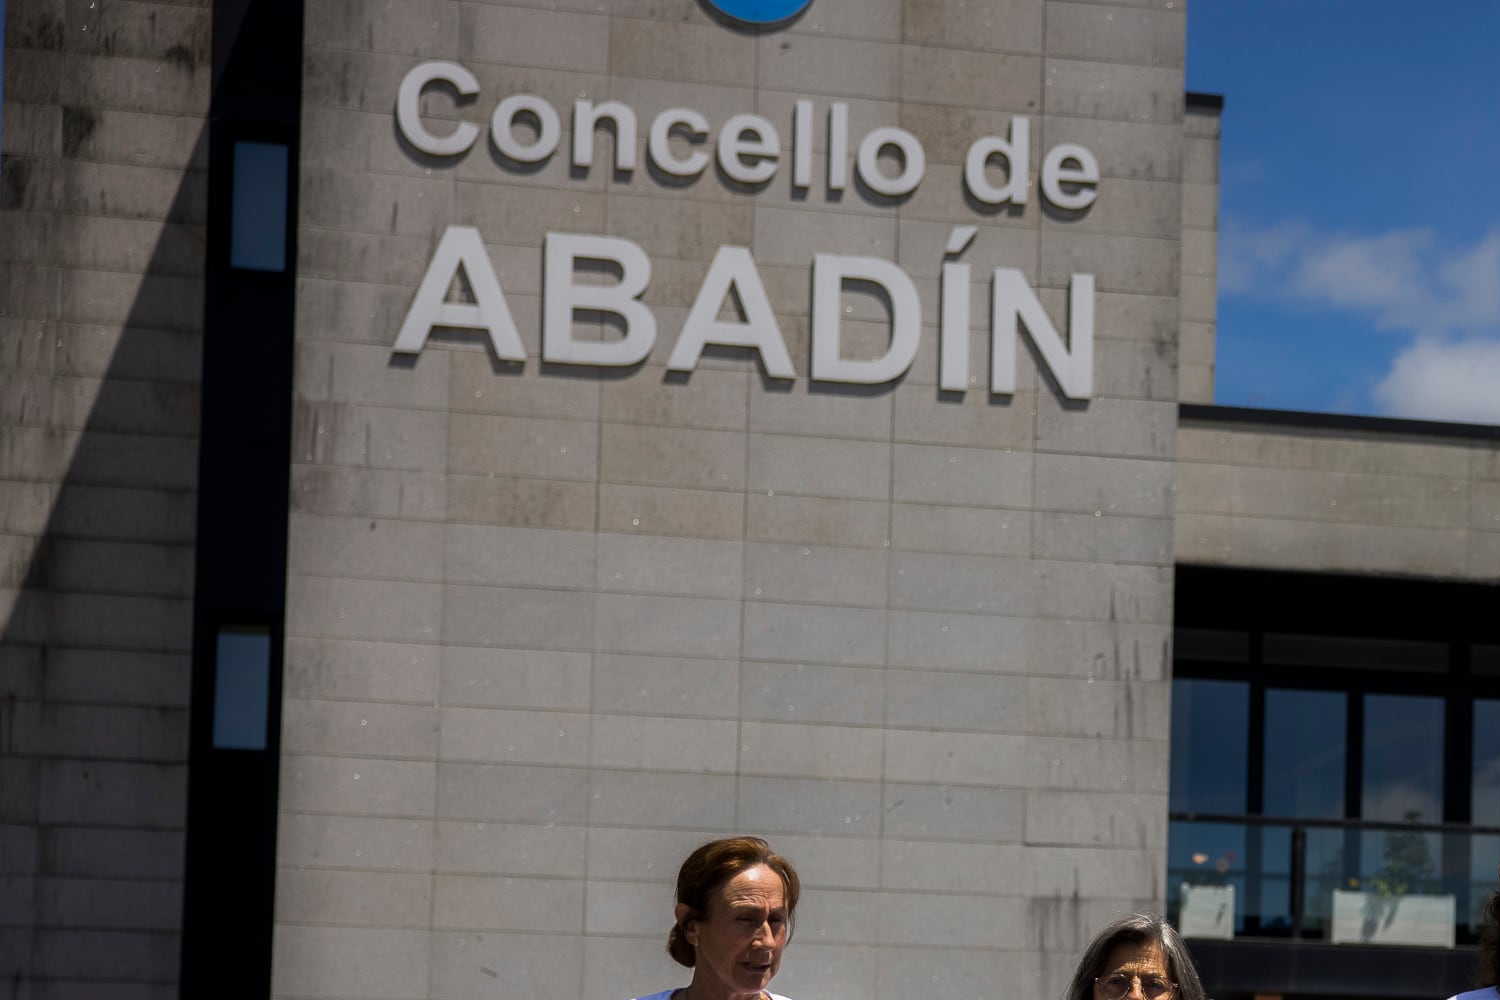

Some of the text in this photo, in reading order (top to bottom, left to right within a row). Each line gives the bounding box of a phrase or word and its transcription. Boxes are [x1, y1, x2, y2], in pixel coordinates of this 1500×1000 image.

[395, 59, 1101, 212] Concello de
[392, 224, 1097, 400] ABADÍN
